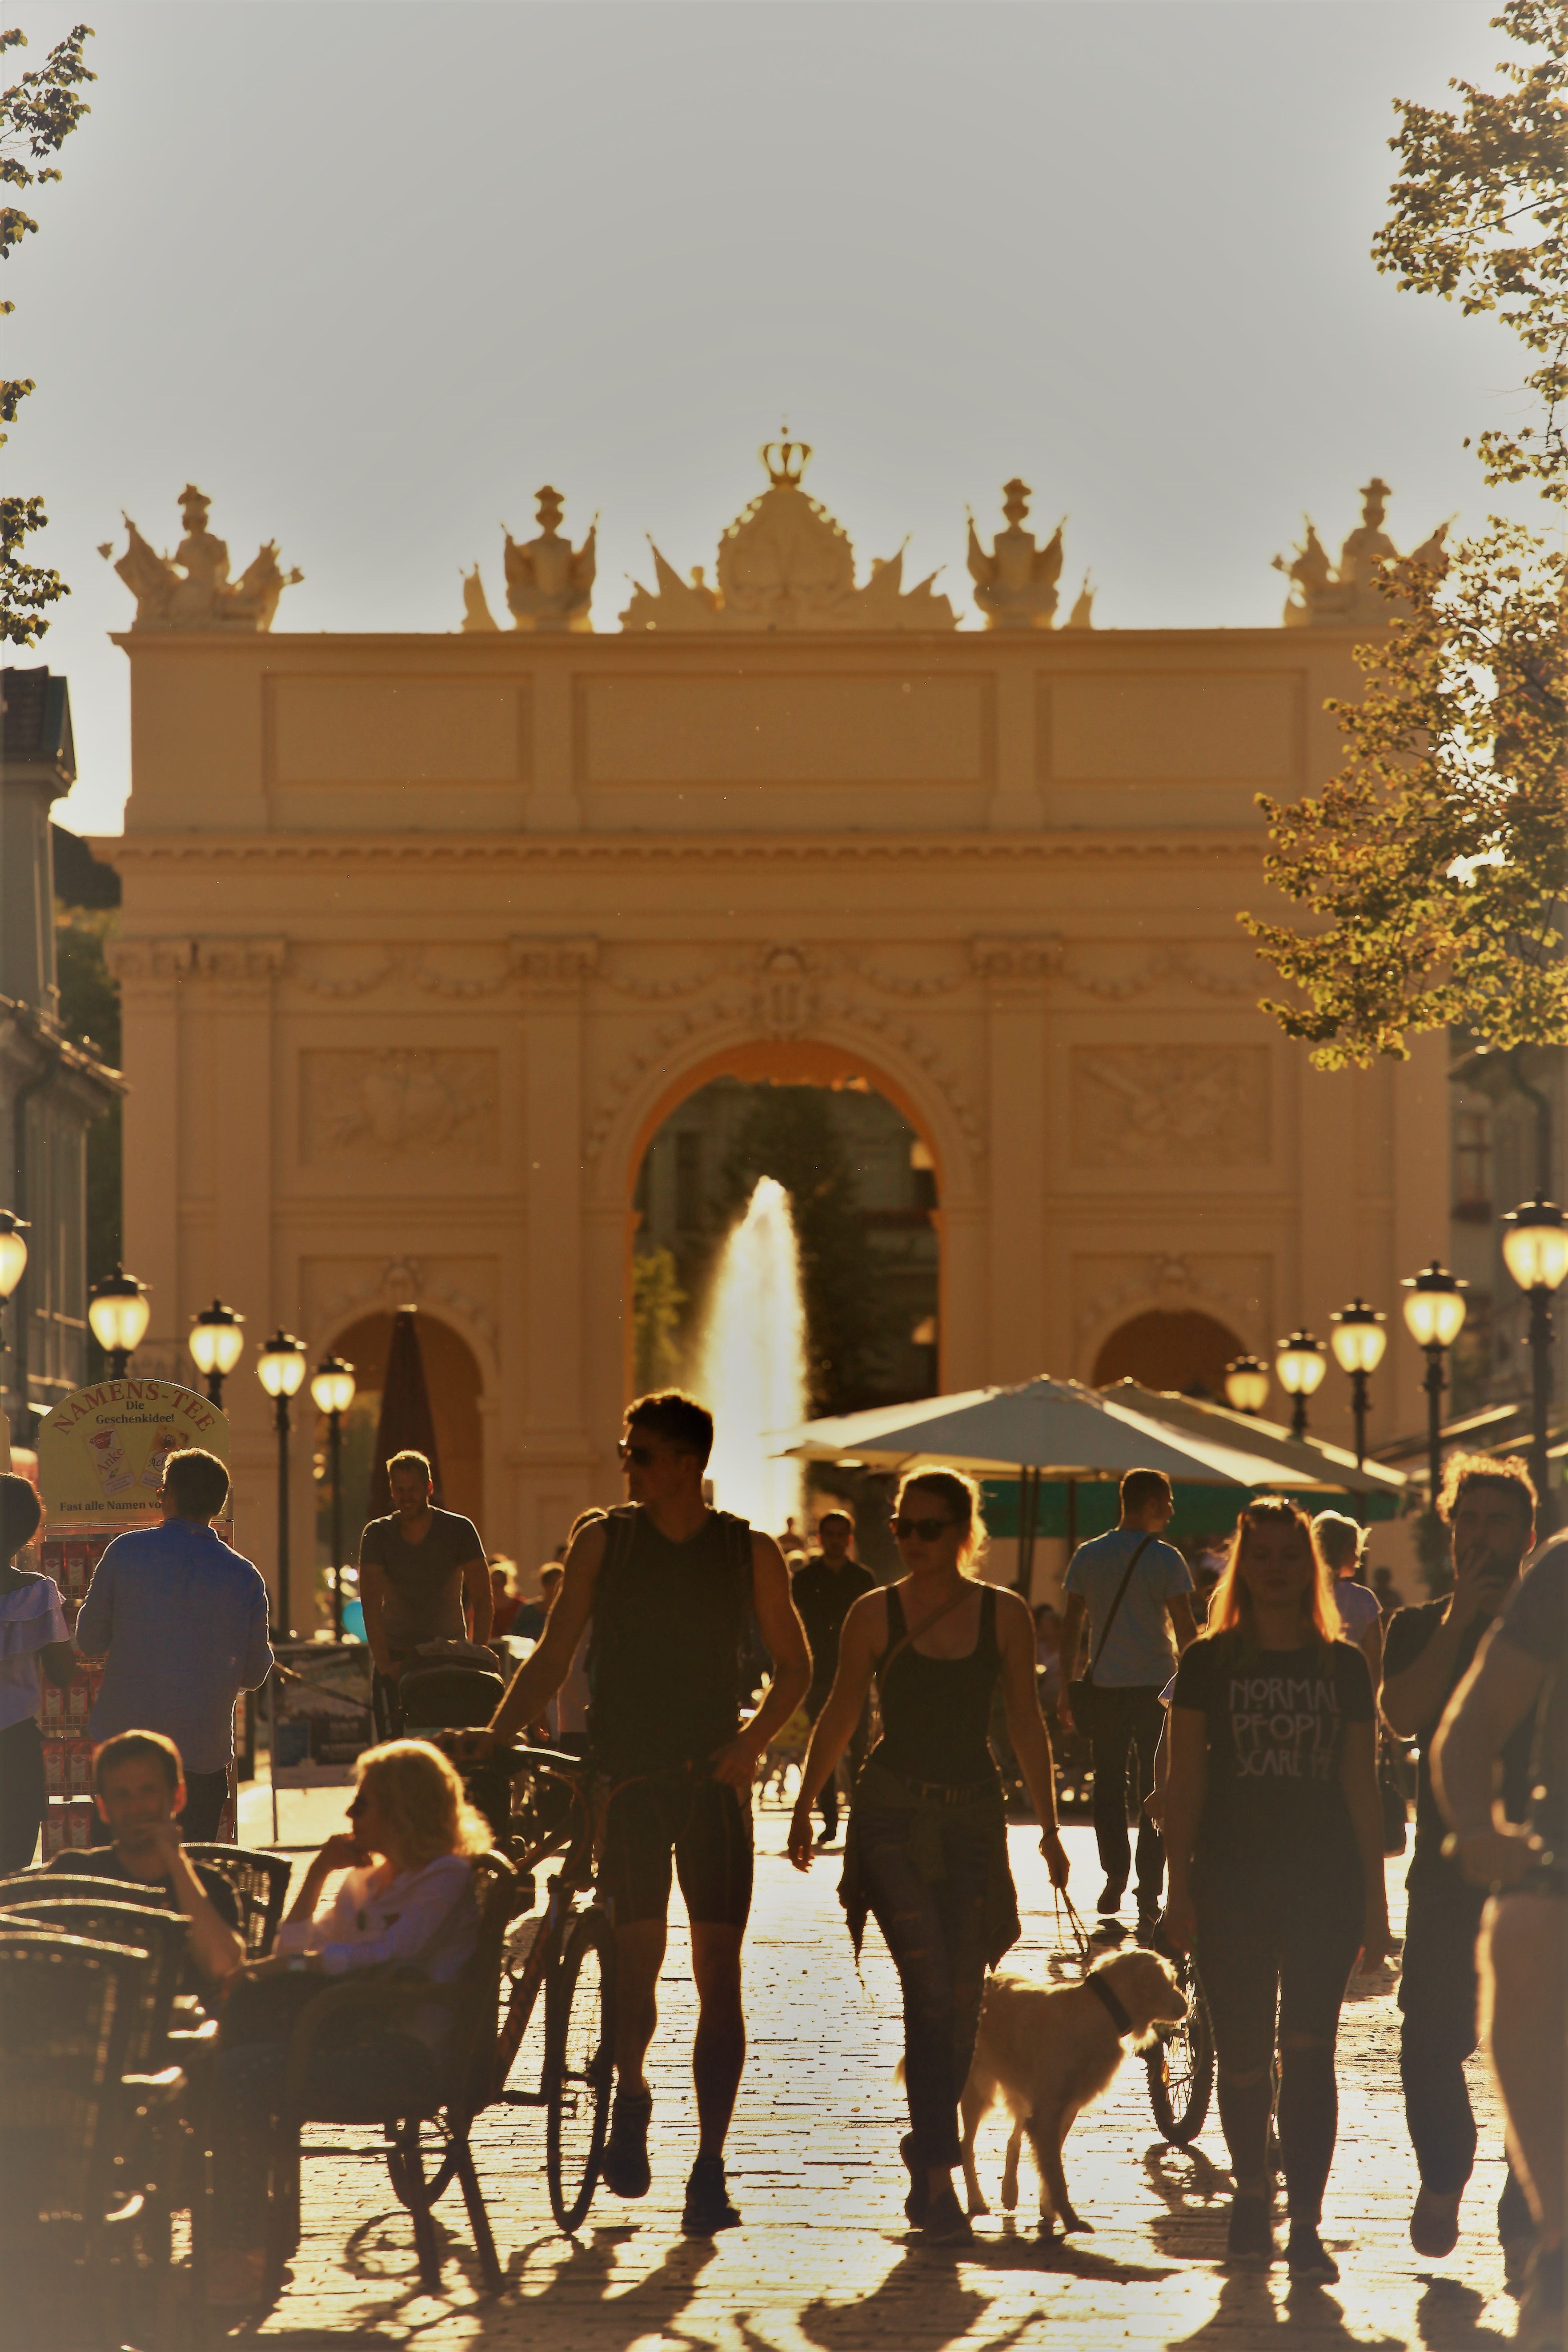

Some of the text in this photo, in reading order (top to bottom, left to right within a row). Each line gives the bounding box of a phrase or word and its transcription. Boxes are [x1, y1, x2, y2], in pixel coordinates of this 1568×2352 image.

[52, 1381, 216, 1435] NAMENS-TEE
[96, 1414, 175, 1424] Geschenkidee!
[126, 1401, 144, 1410] Die
[97, 1448, 124, 1475] Anke
[60, 1502, 82, 1511] Fast
[85, 1501, 104, 1510] alle
[107, 1501, 146, 1510] Namen
[1229, 1677, 1341, 1714] NORMAL
[1236, 1747, 1302, 1777] SCARE
